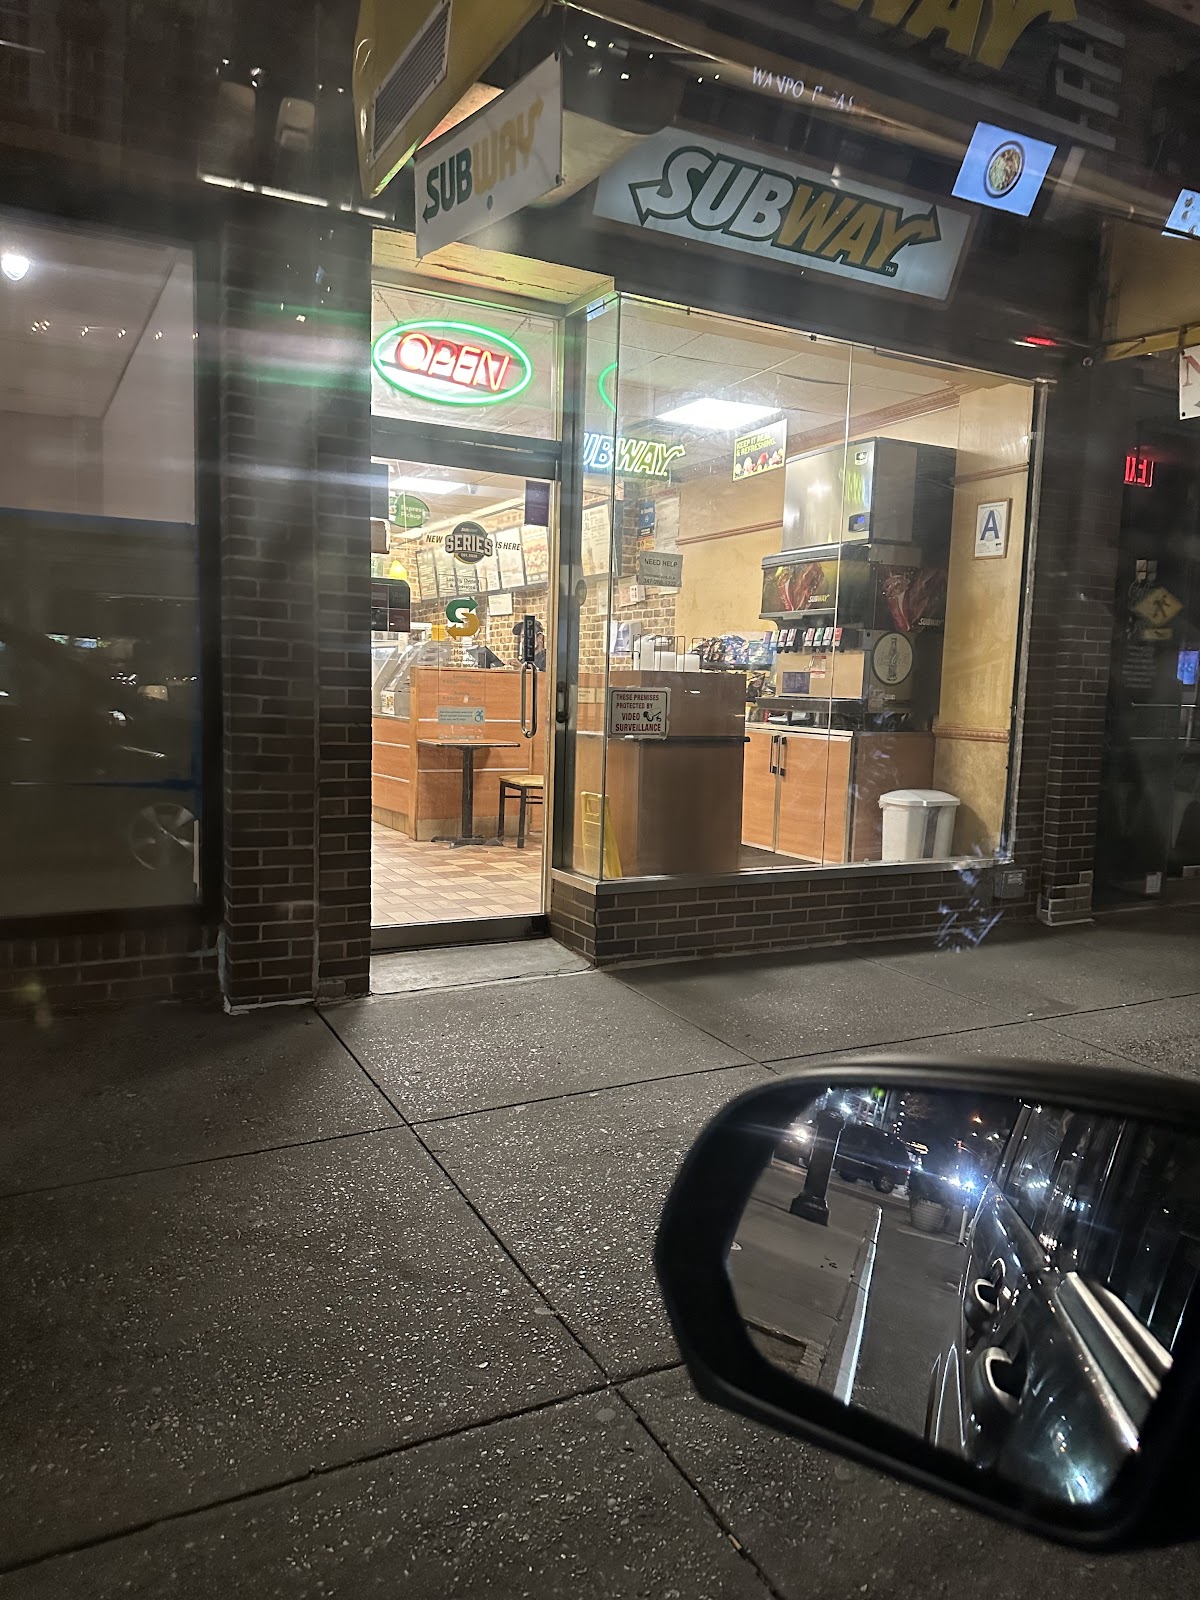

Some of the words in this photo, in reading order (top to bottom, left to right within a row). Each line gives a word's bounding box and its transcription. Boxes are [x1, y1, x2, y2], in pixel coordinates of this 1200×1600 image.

[422, 99, 545, 225] SUBWAY
[628, 145, 942, 277] SUBWAY
[396, 331, 511, 393] OPEN
[583, 432, 686, 477] UBWAY
[980, 510, 1000, 540] A
[426, 534, 443, 544] NEW
[445, 534, 493, 557] SERIES
[503, 541, 521, 551] HERE
[663, 560, 678, 568] HELP
[807, 594, 830, 603] SUBWAY
[526, 619, 534, 658] PULL
[616, 693, 633, 701] THESE
[633, 693, 659, 701] PREMISES
[615, 723, 661, 732] SURVEILLANCE
[621, 712, 640, 721] VIDEO
